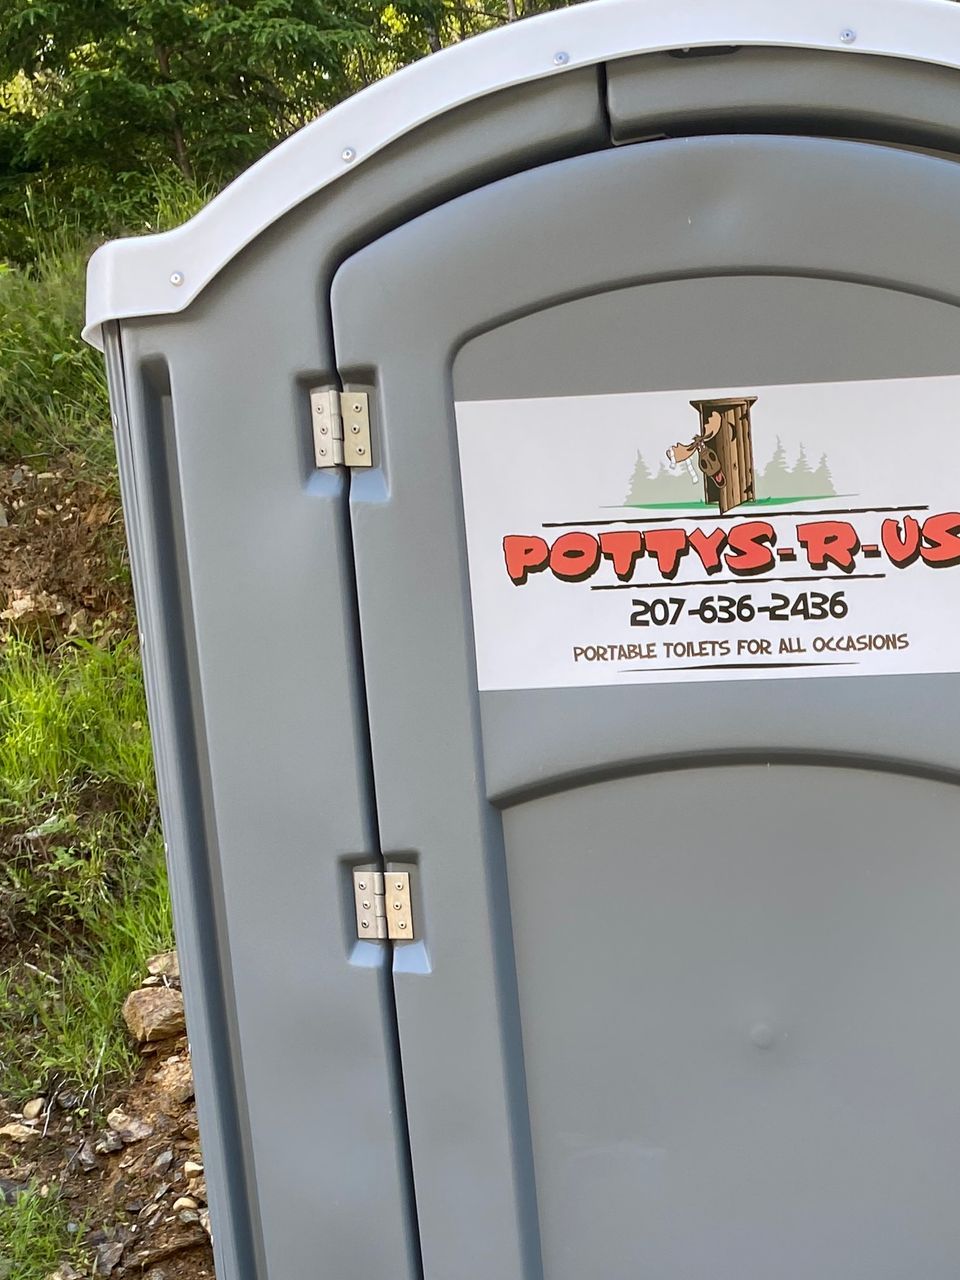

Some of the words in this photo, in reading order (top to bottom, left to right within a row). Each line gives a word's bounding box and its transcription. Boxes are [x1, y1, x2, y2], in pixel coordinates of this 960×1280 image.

[629, 590, 849, 628] 207-636-2436
[573, 642, 658, 663] PORTABLE
[662, 639, 731, 659] TOILETS
[737, 638, 773, 656] FOR
[778, 636, 807, 655] ALL
[812, 633, 911, 653] OCCASIONS
